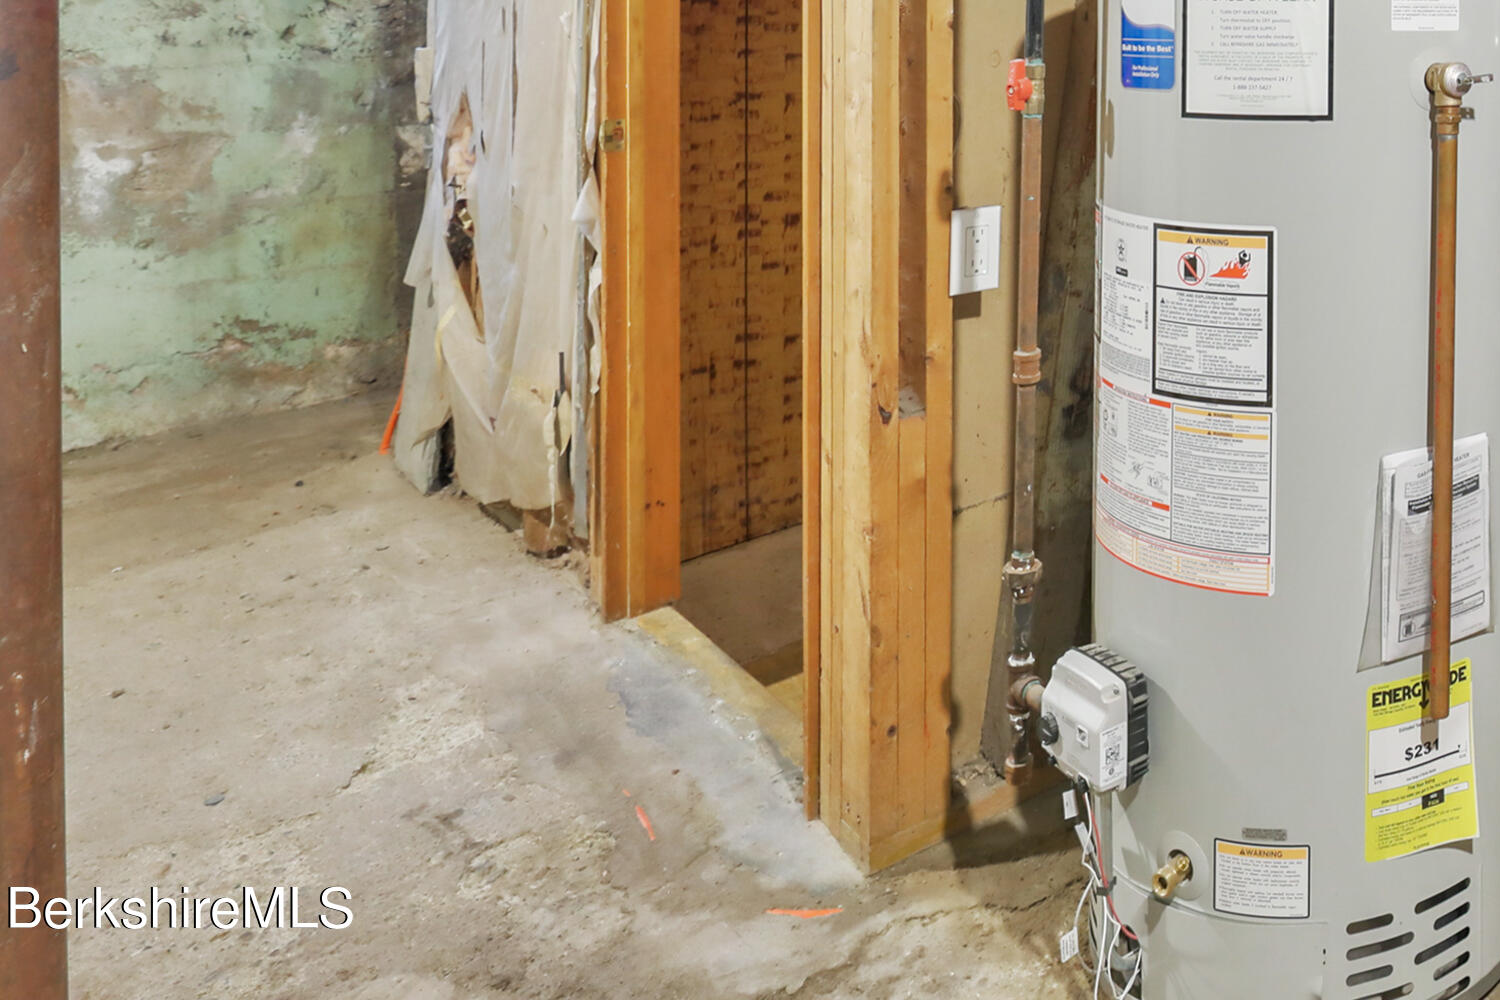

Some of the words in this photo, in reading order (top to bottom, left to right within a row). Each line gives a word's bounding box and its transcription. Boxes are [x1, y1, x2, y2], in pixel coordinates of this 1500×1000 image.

[1195, 238, 1229, 246] WARNING
[1405, 738, 1440, 761] $231
[1246, 848, 1283, 858] WARNING
